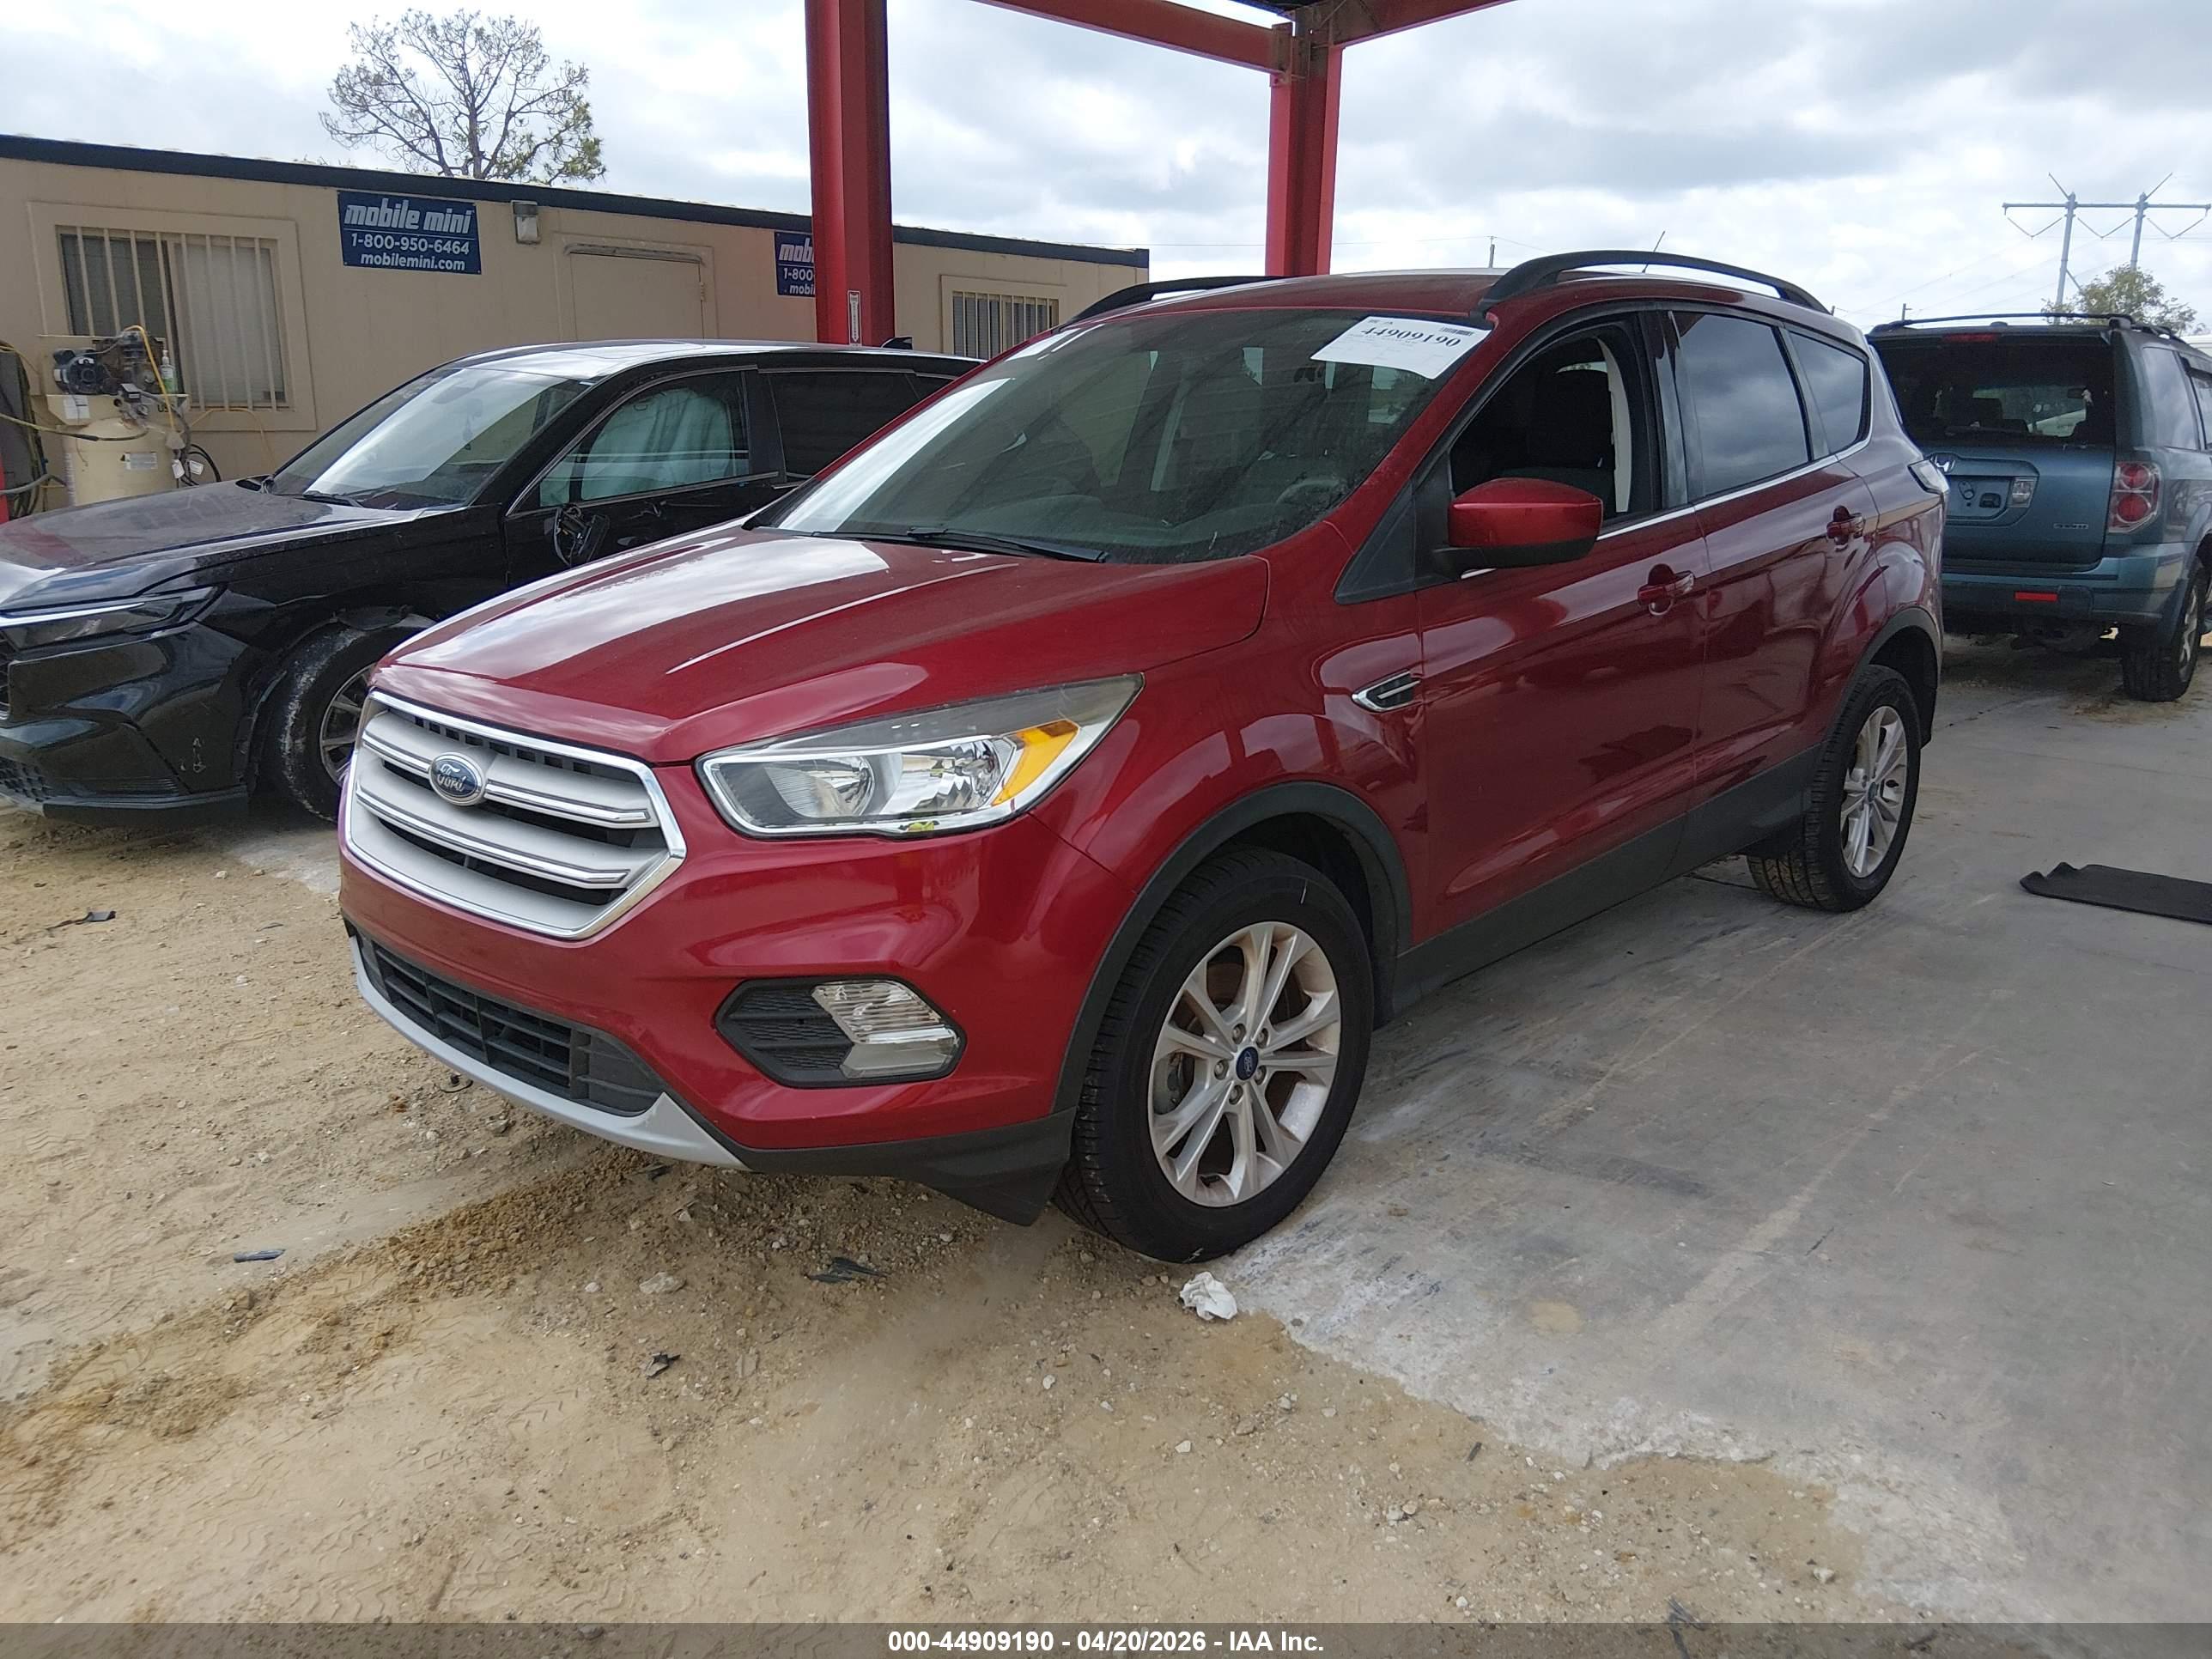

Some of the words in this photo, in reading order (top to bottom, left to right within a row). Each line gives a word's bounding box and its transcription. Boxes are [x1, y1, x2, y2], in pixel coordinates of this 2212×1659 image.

[343, 198, 420, 229] mobile
[423, 209, 471, 234] mini
[351, 233, 470, 254] 1-800-950-6464
[361, 252, 465, 270] mobilemini.com
[1361, 327, 1461, 347] 44909190
[436, 763, 467, 792] Ford
